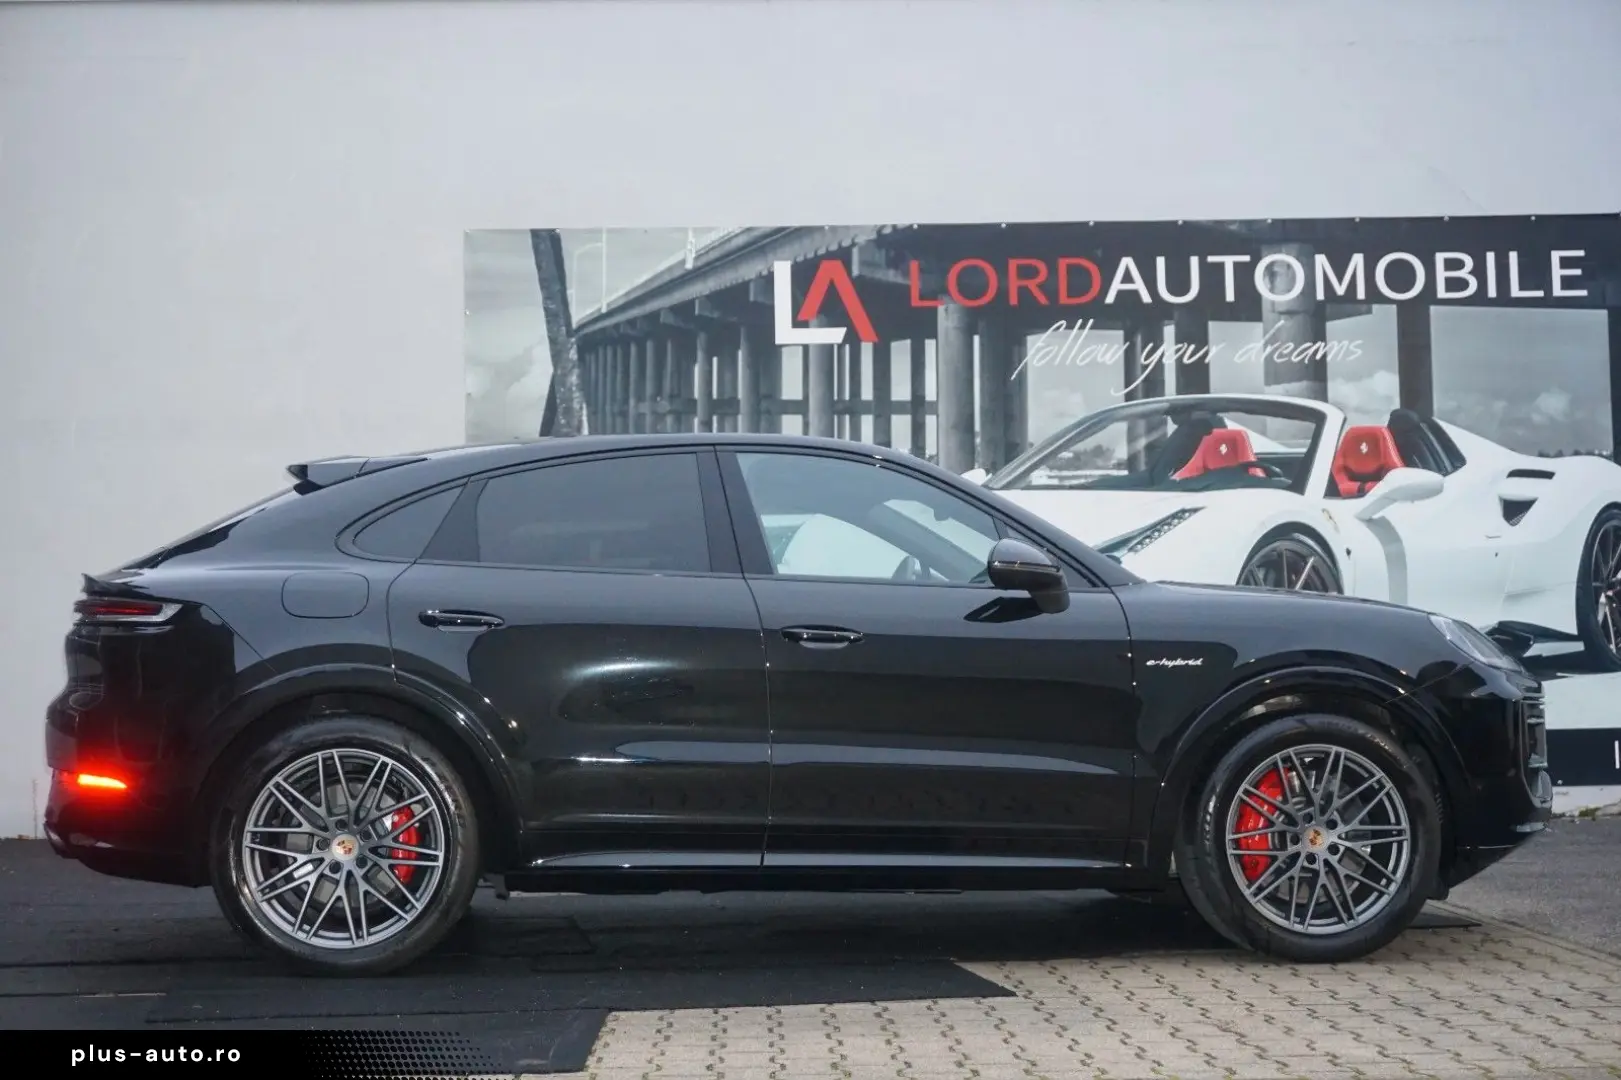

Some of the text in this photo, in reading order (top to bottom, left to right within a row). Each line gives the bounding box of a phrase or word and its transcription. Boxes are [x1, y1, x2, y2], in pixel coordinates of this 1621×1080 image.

[773, 258, 879, 346] LA
[910, 250, 1589, 307] LORDAUTOMOBILE
[1011, 319, 1364, 396] follow your dreams
[1146, 658, 1203, 668] e-hybrid
